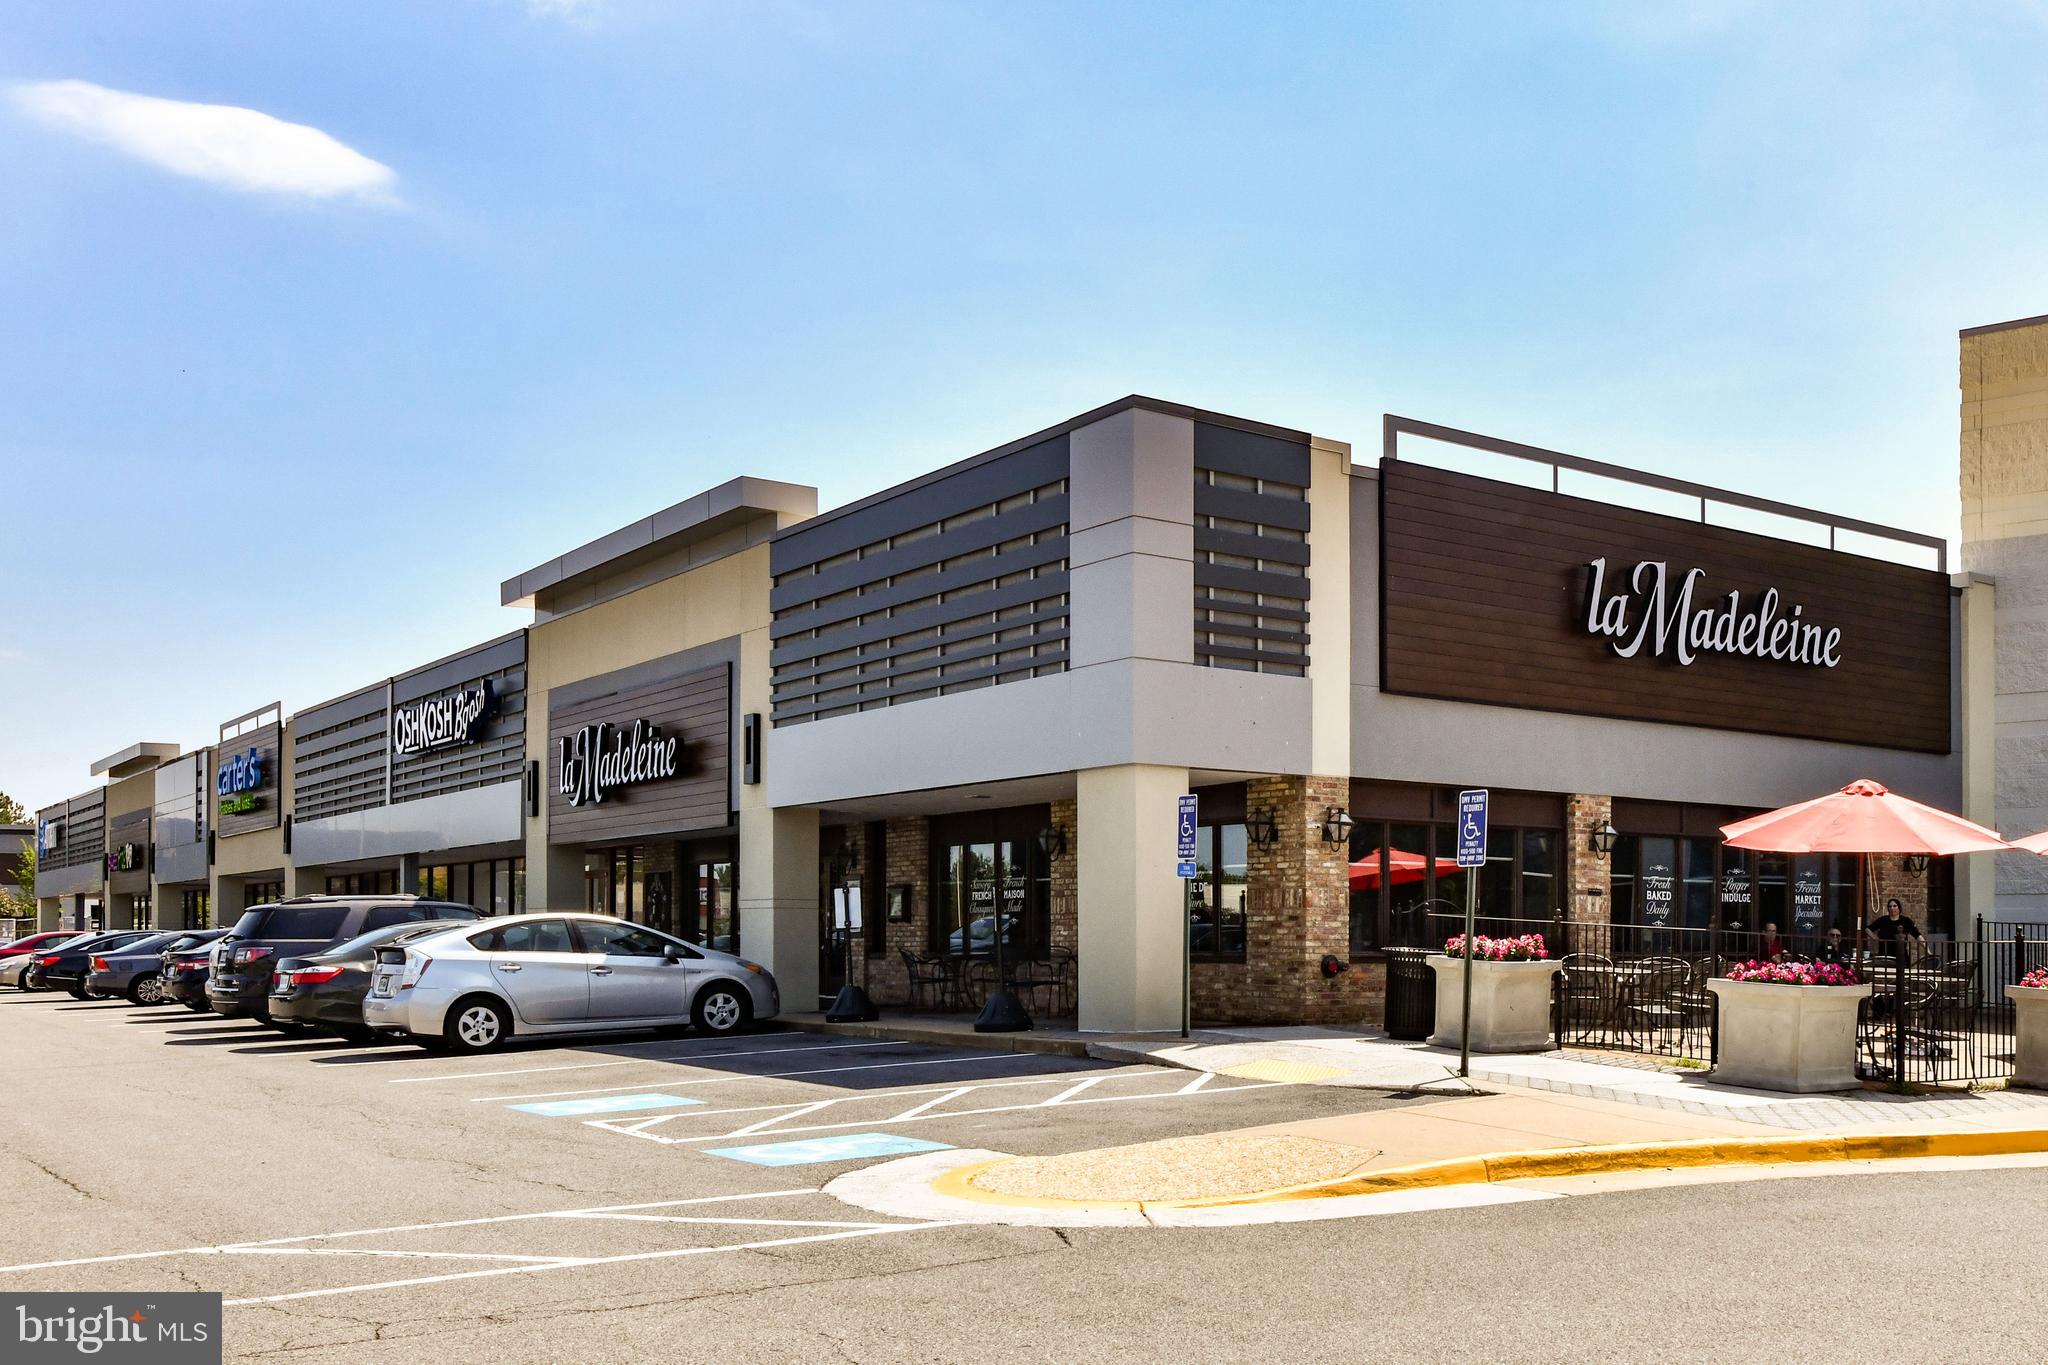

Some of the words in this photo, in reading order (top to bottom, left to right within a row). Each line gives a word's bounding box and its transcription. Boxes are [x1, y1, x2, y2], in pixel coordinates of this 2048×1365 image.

[1587, 556, 1630, 637] la
[1613, 560, 1841, 668] Madeleine
[559, 736, 575, 794] la
[569, 718, 677, 807] Madeleine
[217, 748, 257, 796] carter's
[1646, 876, 1671, 889] Fresh
[1723, 877, 1750, 894] Linger
[1795, 881, 1822, 894] French
[972, 891, 992, 900] FRENCH
[1003, 889, 1025, 899] MAISON
[1646, 890, 1672, 901] BAKED
[1721, 892, 1751, 903] INDULGE
[1795, 895, 1822, 905] MARKET
[1646, 901, 1670, 919] Daily
